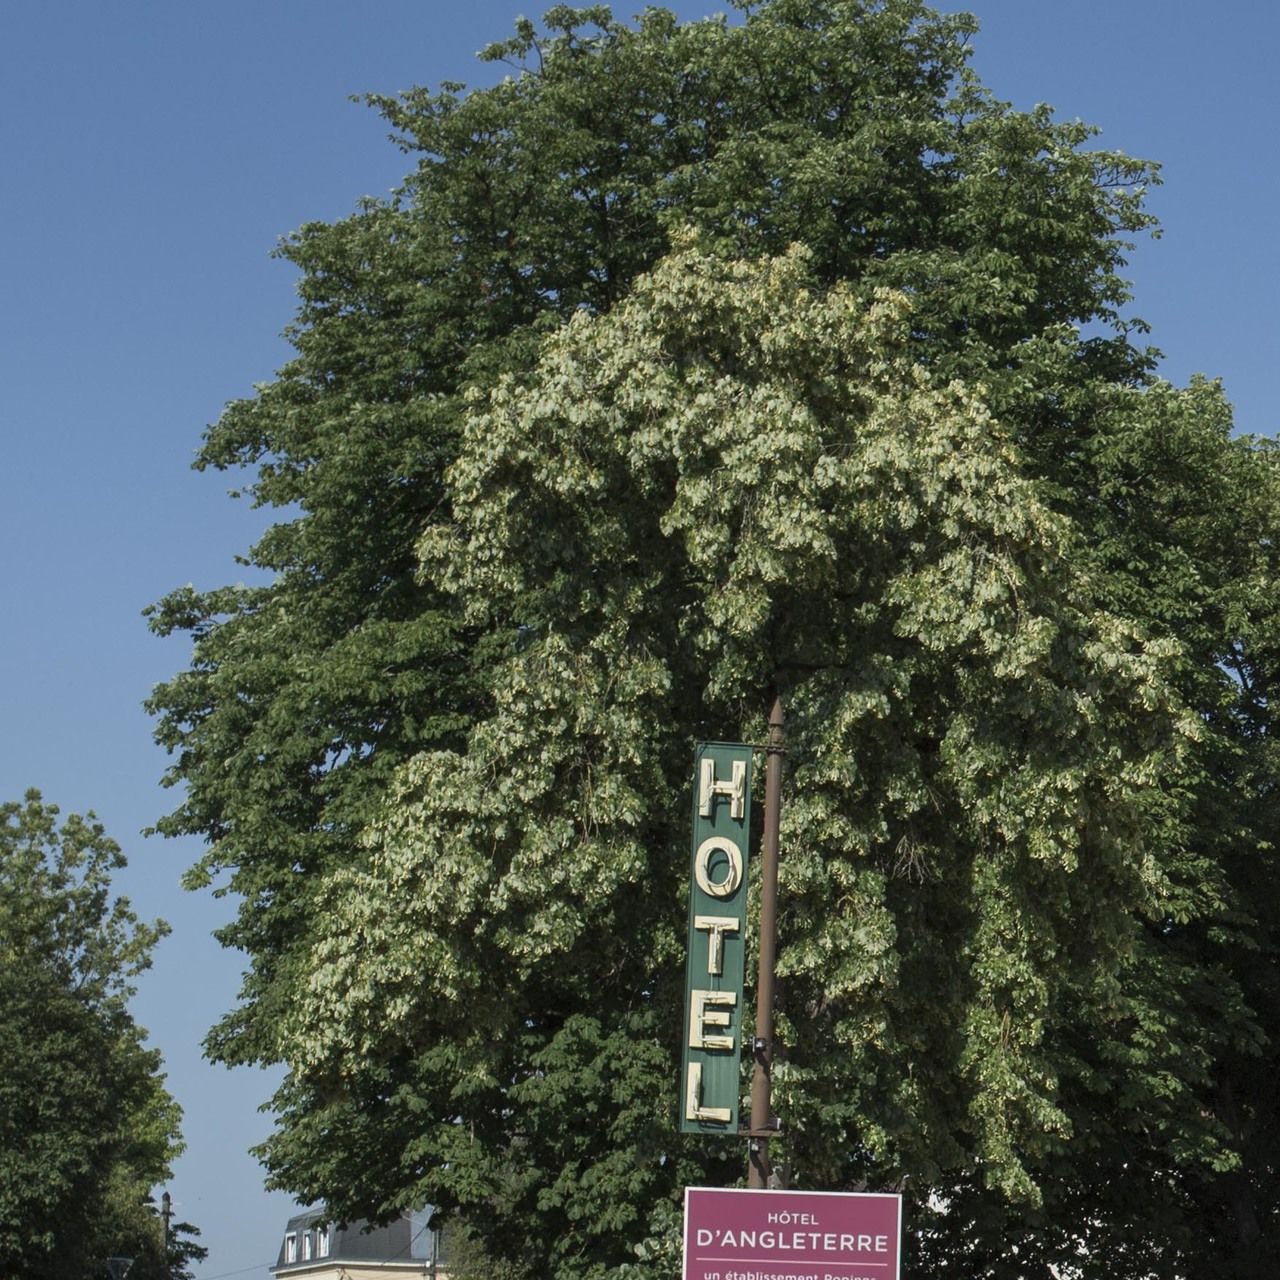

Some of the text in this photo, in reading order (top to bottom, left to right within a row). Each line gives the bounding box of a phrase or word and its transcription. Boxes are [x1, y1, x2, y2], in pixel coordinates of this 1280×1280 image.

[686, 758, 746, 1122] HOTEL
[767, 1210, 819, 1225] HÔTEL
[696, 1229, 888, 1252] D'ANGLETERRE
